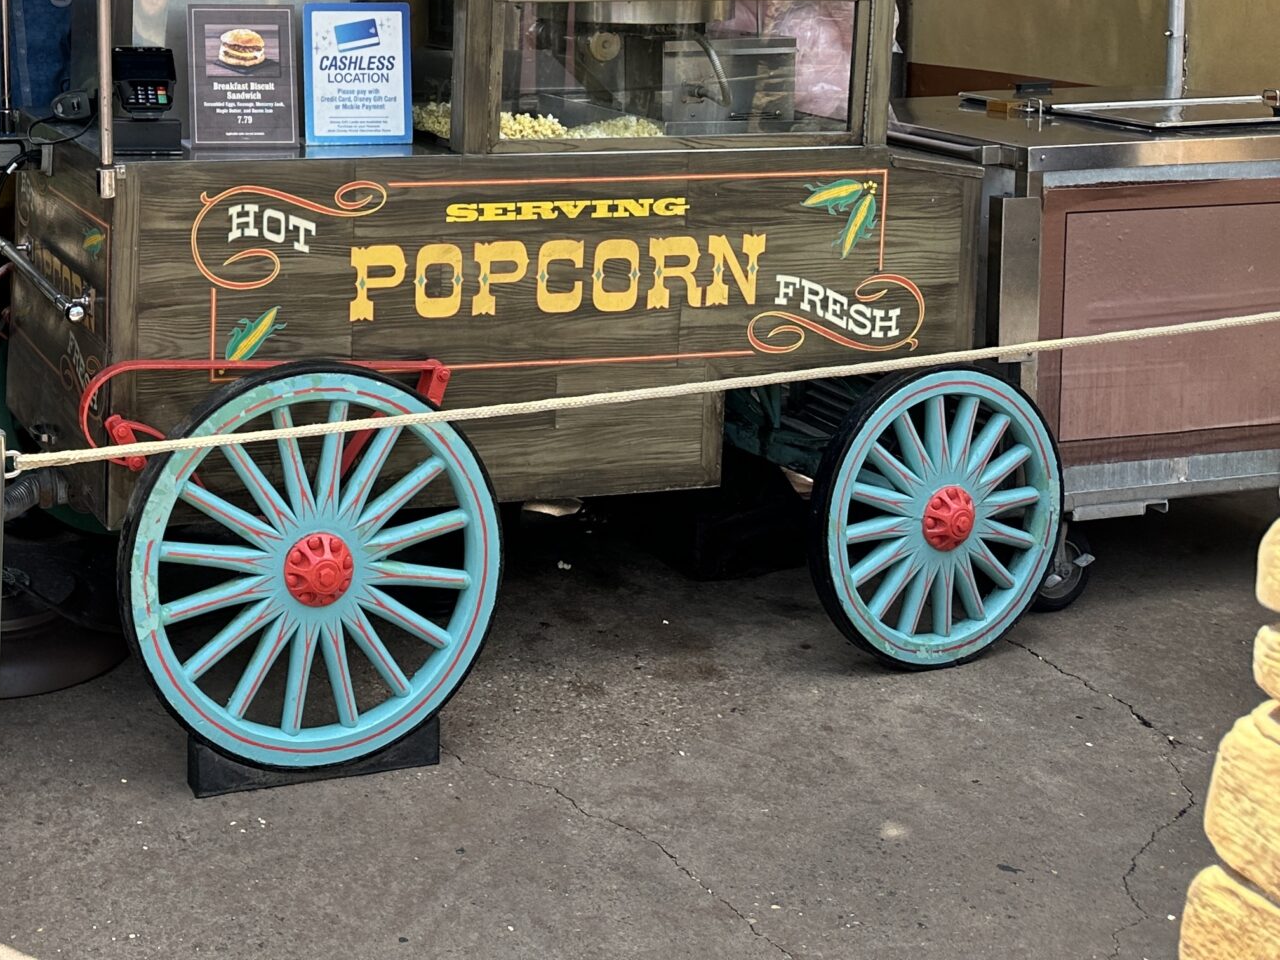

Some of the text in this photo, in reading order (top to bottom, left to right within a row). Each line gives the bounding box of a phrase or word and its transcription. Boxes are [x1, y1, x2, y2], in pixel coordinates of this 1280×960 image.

[319, 55, 396, 71] CASHLESS
[327, 72, 390, 84] LOCATION
[213, 82, 275, 91] Breakfast Biscuit
[226, 91, 262, 100] Sandwich
[354, 96, 372, 104] Disney
[237, 116, 253, 124] 7.79
[445, 198, 690, 223] SERVING
[228, 204, 316, 253] HOT
[349, 234, 766, 322] POPCORN
[774, 274, 901, 338] FRESH
